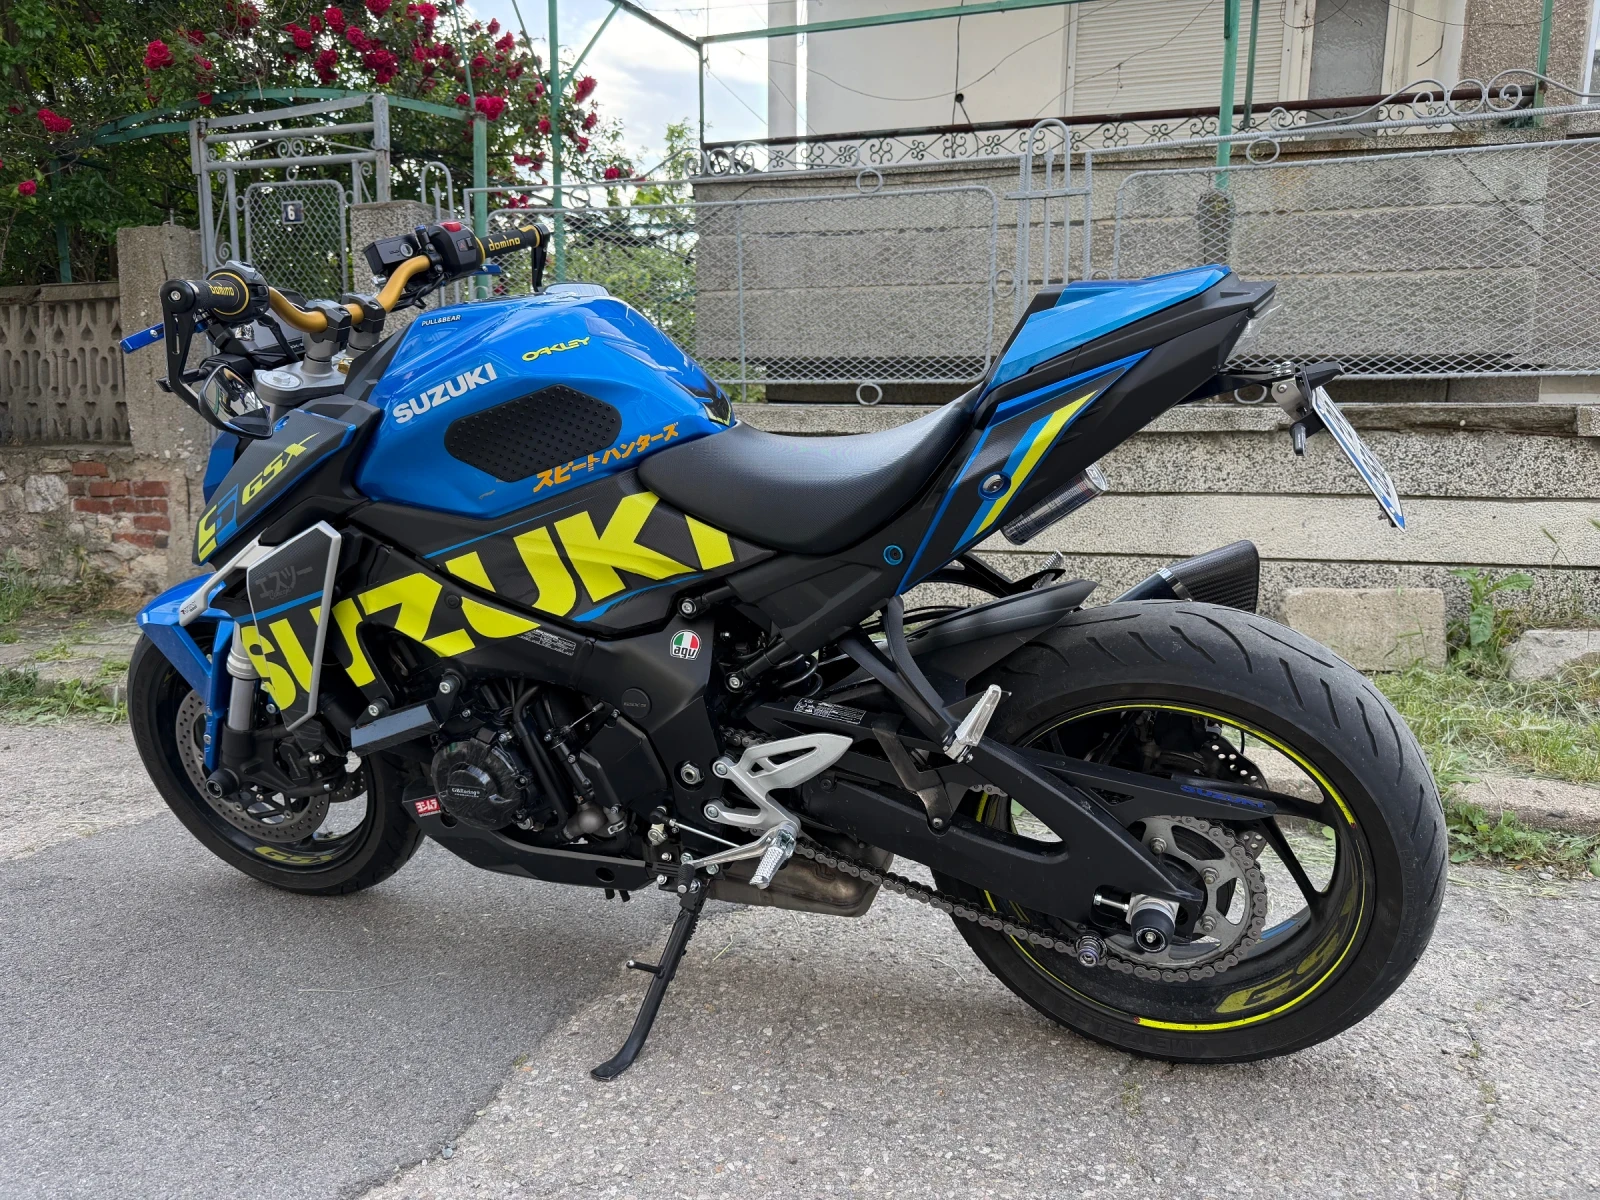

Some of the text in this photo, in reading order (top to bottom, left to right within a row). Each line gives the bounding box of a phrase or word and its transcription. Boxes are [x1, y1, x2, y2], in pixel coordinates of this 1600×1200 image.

[287, 205, 296, 221] 6
[488, 234, 521, 252] domino
[421, 314, 462, 327] PULL&BEAR
[521, 336, 591, 362] OAKLEY
[392, 362, 498, 425] SUZUKI
[241, 432, 320, 506] GSX
[241, 490, 735, 711] SUZUKI
[673, 646, 697, 658] agv
[414, 798, 439, 813] ヨシムラ
